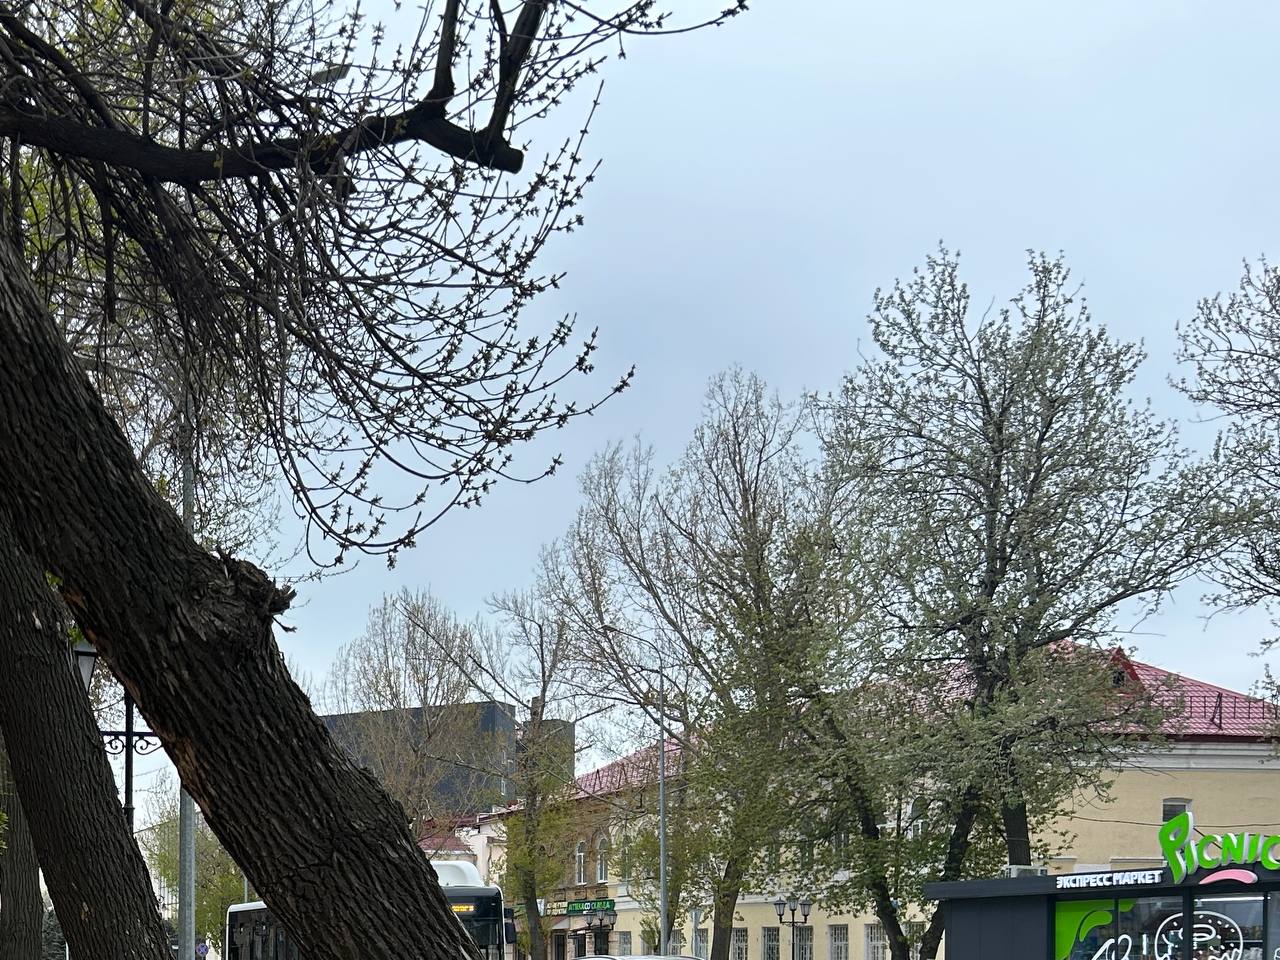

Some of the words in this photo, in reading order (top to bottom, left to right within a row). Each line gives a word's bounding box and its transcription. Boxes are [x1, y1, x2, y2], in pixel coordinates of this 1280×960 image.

[1159, 811, 1280, 884] PICNIC
[1056, 874, 1113, 889] ЭКСПРЕСС
[1112, 870, 1163, 885] МАРКЕТ
